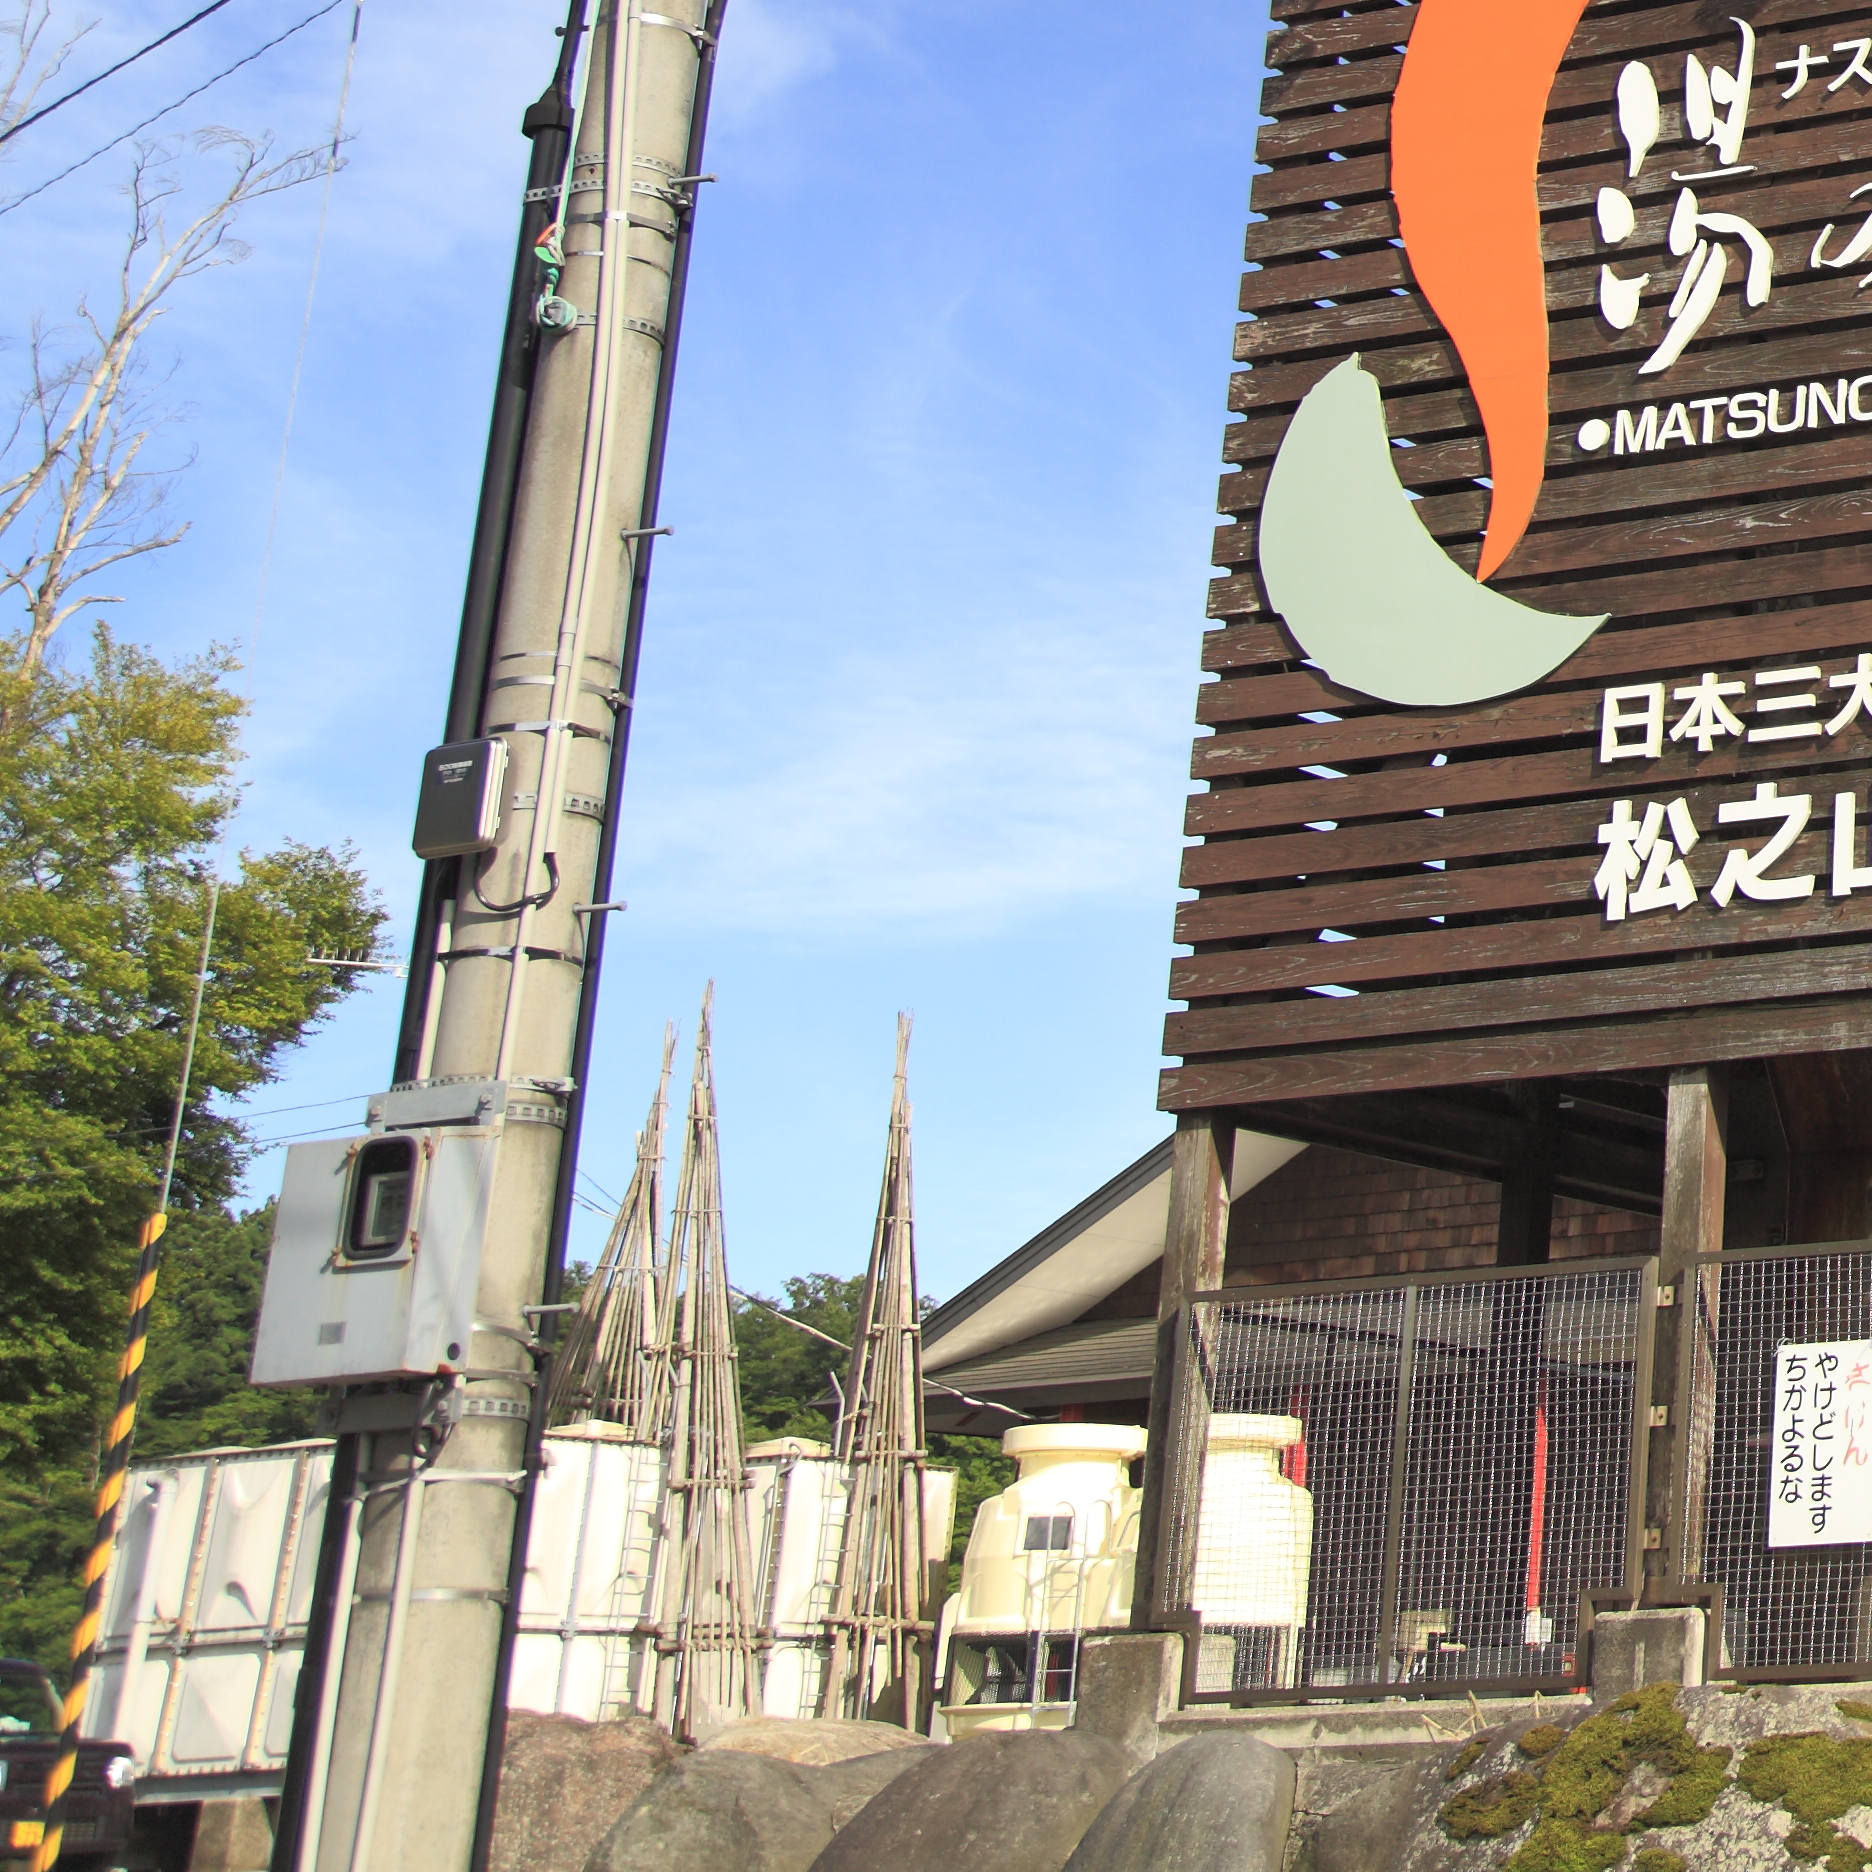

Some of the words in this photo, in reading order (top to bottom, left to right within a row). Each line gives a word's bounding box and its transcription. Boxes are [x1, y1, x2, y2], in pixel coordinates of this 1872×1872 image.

[1779, 1353, 1808, 1504] ちかよるな
[1809, 1351, 1839, 1534] やけどします
